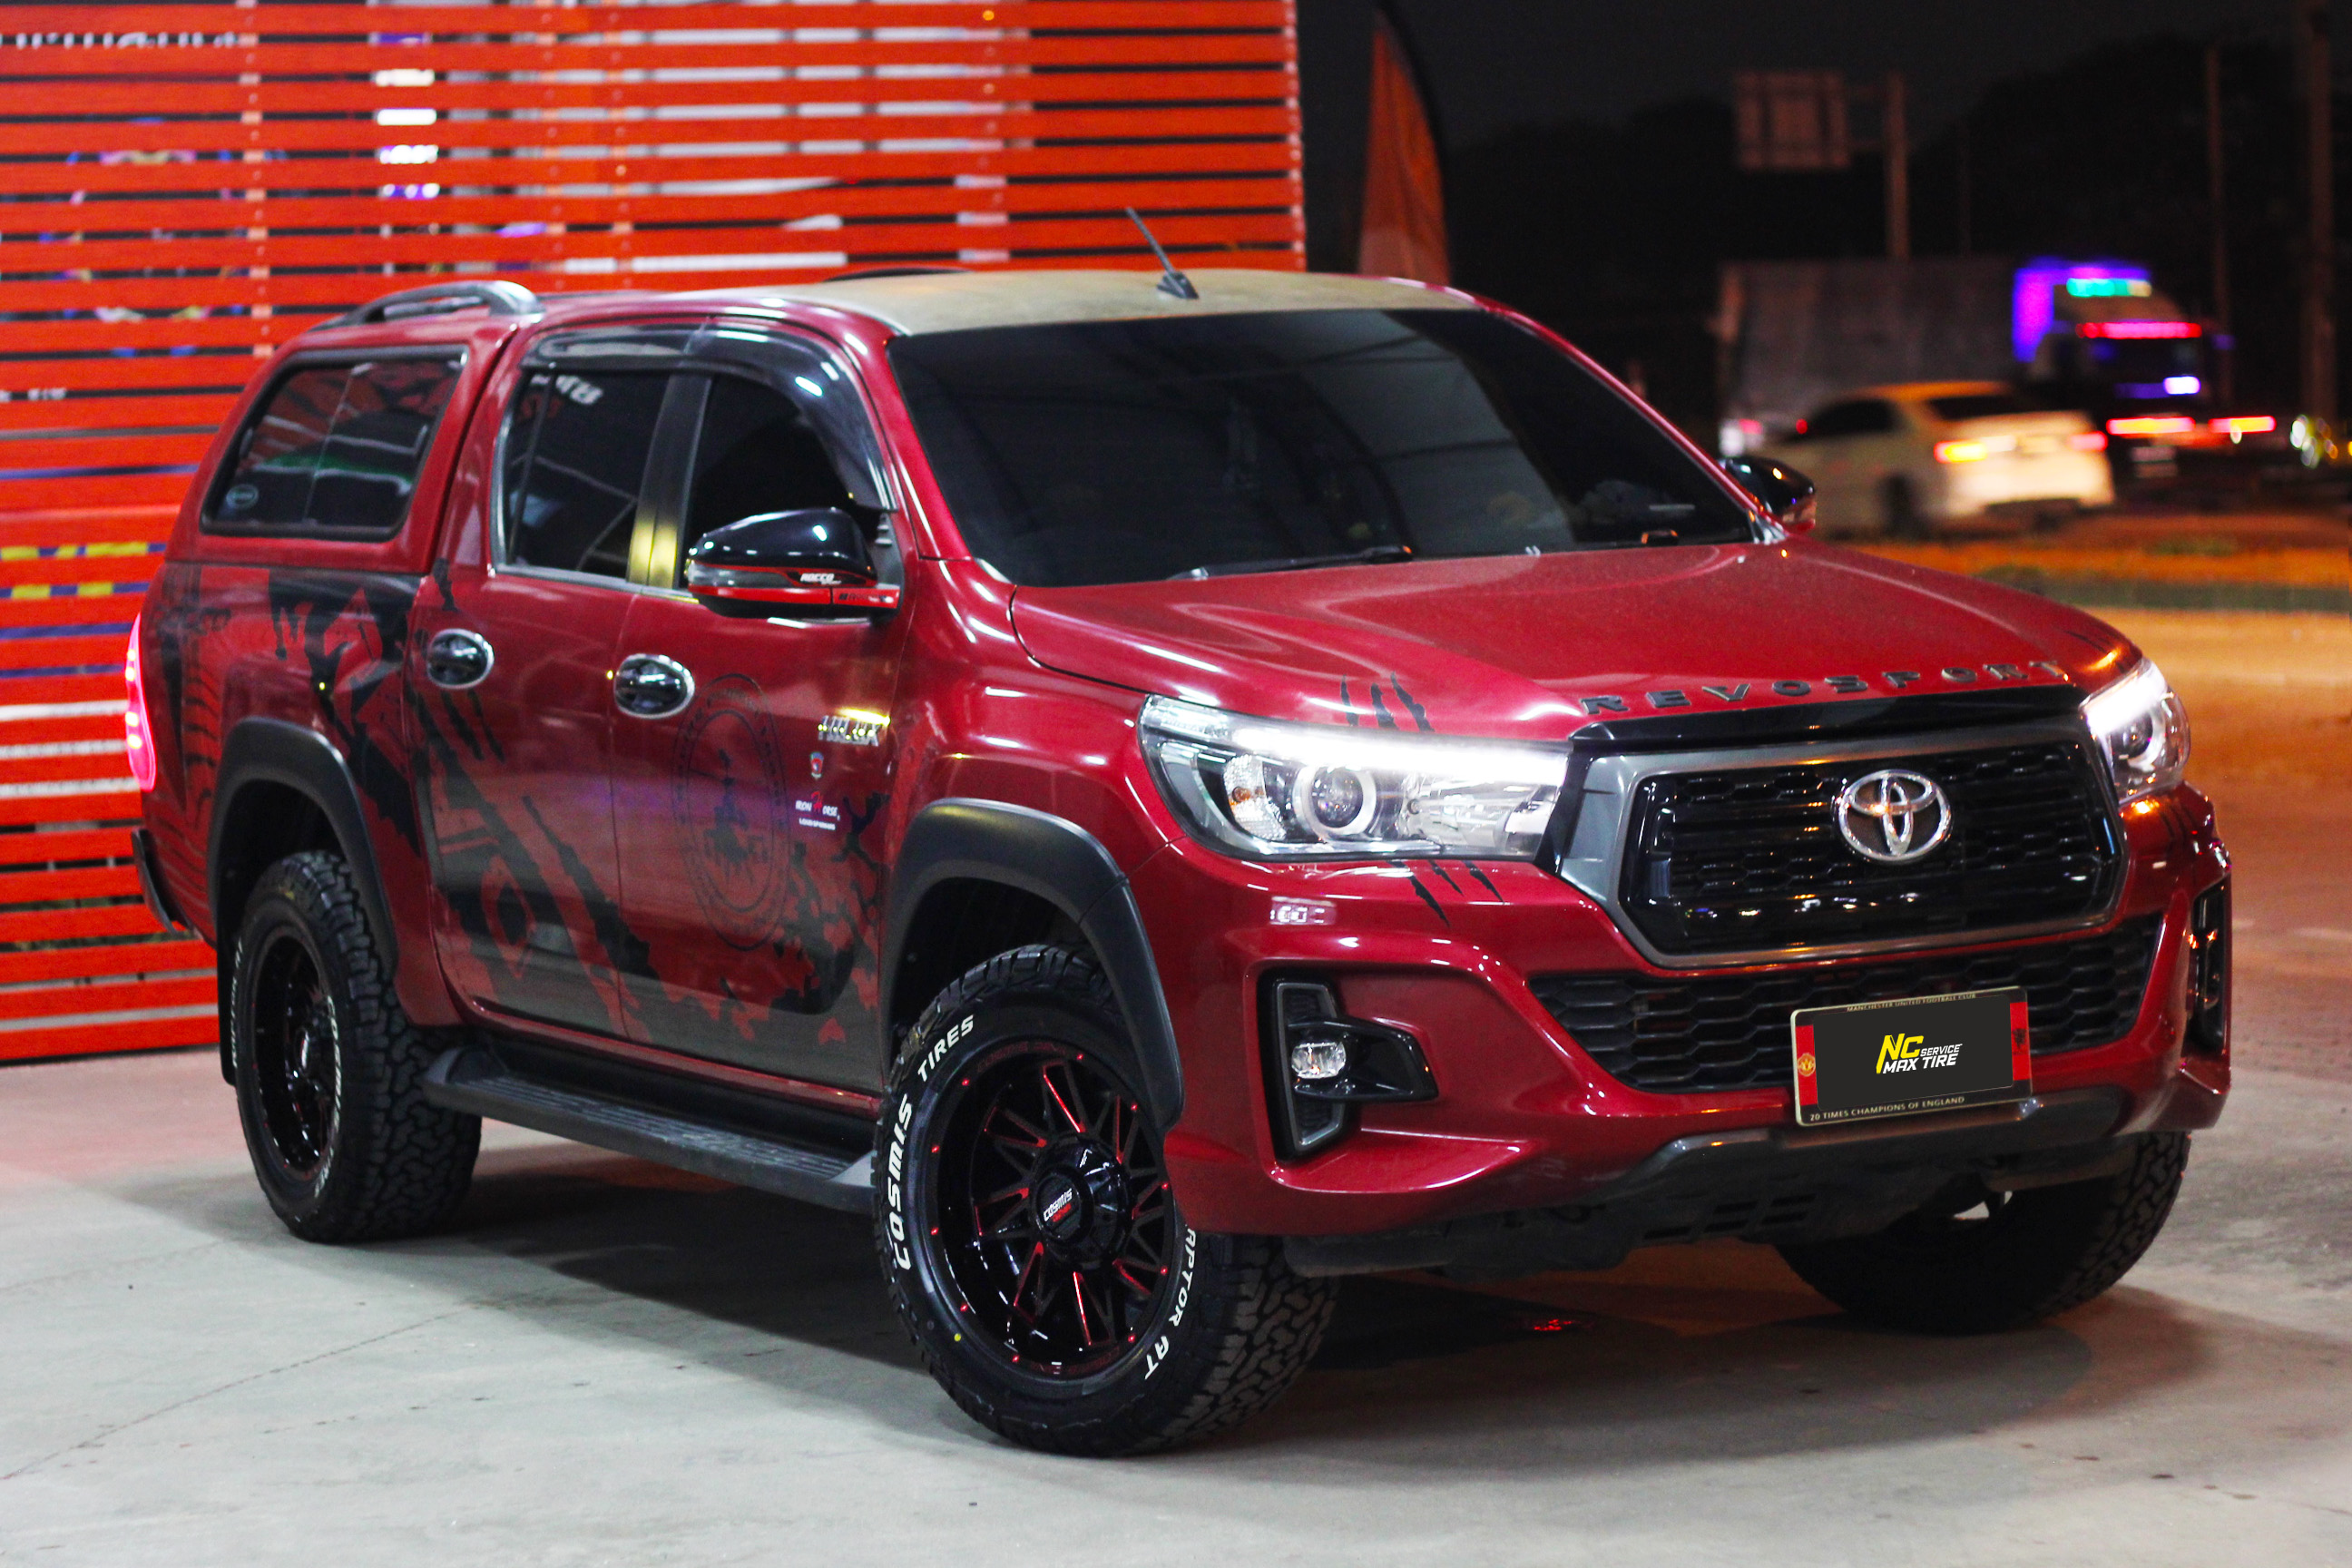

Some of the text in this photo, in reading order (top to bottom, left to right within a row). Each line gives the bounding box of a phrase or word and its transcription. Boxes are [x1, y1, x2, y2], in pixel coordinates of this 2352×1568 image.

[1579, 661, 2070, 715] REVOSPORT
[795, 799, 812, 812] IRON
[1847, 992, 1976, 1013] MANCHESTER UNITED FOOTBALL CLUB
[1810, 1096, 1965, 1122] 20 TIMES CHAMPIONS OF ENGLAND
[887, 1014, 975, 1270] COSMIS TIRES
[1044, 1188, 1073, 1221] COSMIS
[1144, 1227, 1197, 1380] APTOR AT
